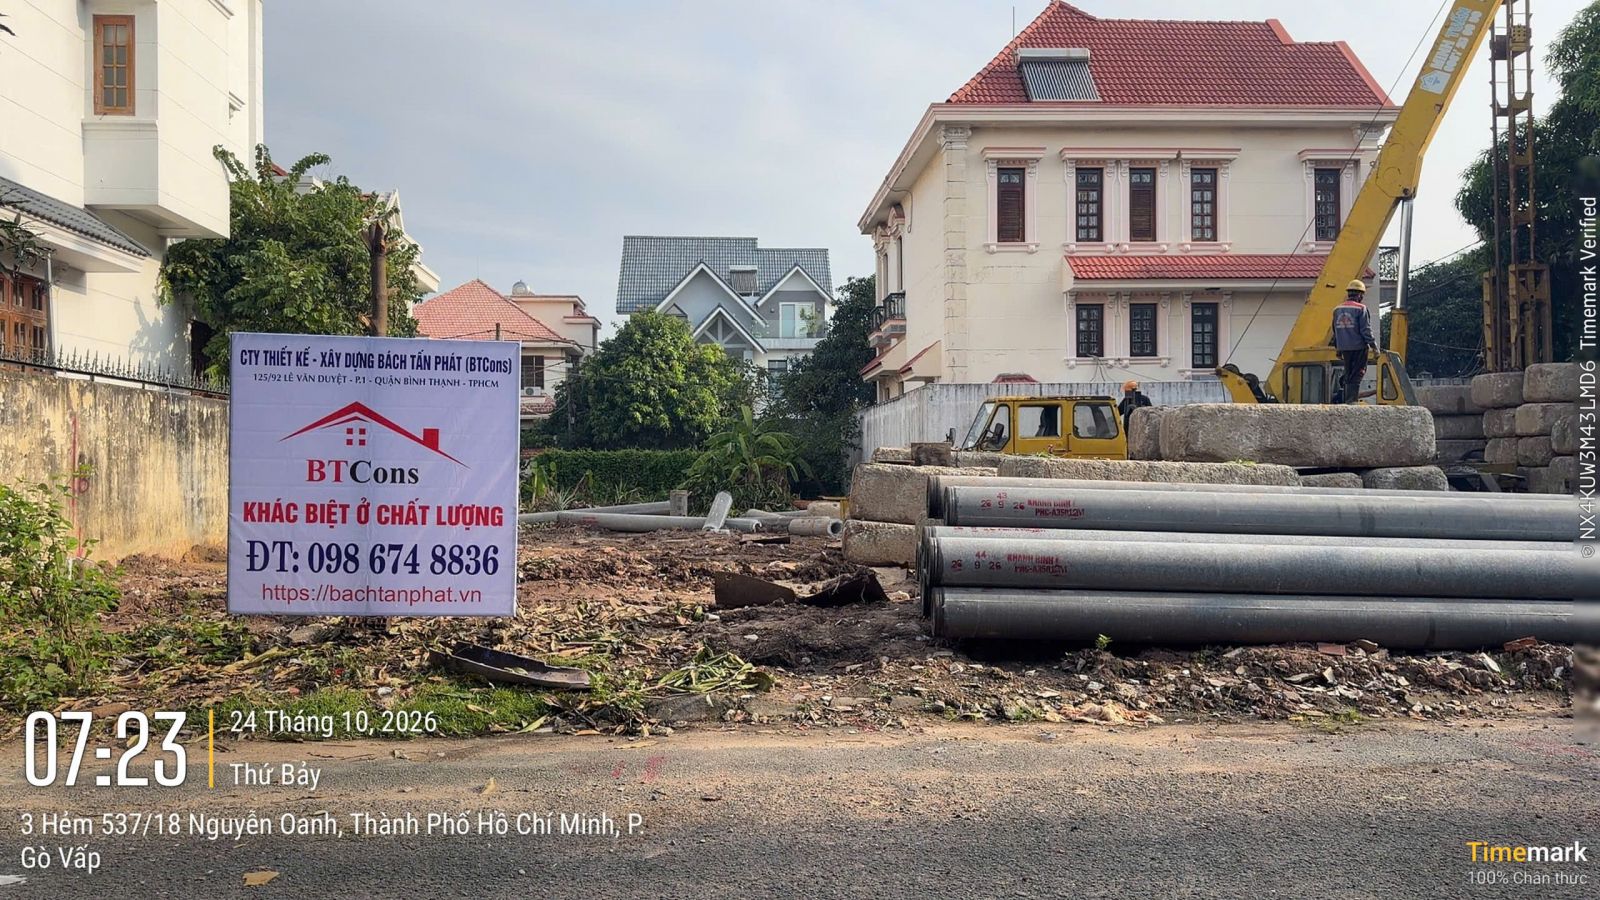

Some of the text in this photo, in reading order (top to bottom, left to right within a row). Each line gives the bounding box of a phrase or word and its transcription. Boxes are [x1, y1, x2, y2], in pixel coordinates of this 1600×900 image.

[240, 349, 261, 366] CTY
[263, 345, 293, 367] THIẾT
[295, 346, 311, 367] KẾ
[319, 349, 342, 368] XÂY
[344, 352, 374, 372] DỰNG
[377, 350, 407, 370] BÁCH
[409, 349, 431, 371] TẤN
[434, 352, 463, 372] PHÁT
[465, 356, 512, 375] (BTCons)
[253, 373, 282, 383] 125/92
[283, 371, 294, 382] LÊ
[296, 373, 316, 383] VĂN
[317, 373, 347, 385] DUYỆT
[374, 374, 401, 387] QUẬN
[403, 375, 426, 386] BÌNH
[428, 377, 461, 389] THẠNH
[468, 379, 499, 388] TPHCM
[306, 458, 419, 485] BTCons
[243, 496, 504, 531] KHÁC BIỆT Ở CHẤT LƯỢNG
[246, 540, 500, 576] ĐT: 098 674 8836
[262, 584, 482, 606] https://bachtanphat.vn
